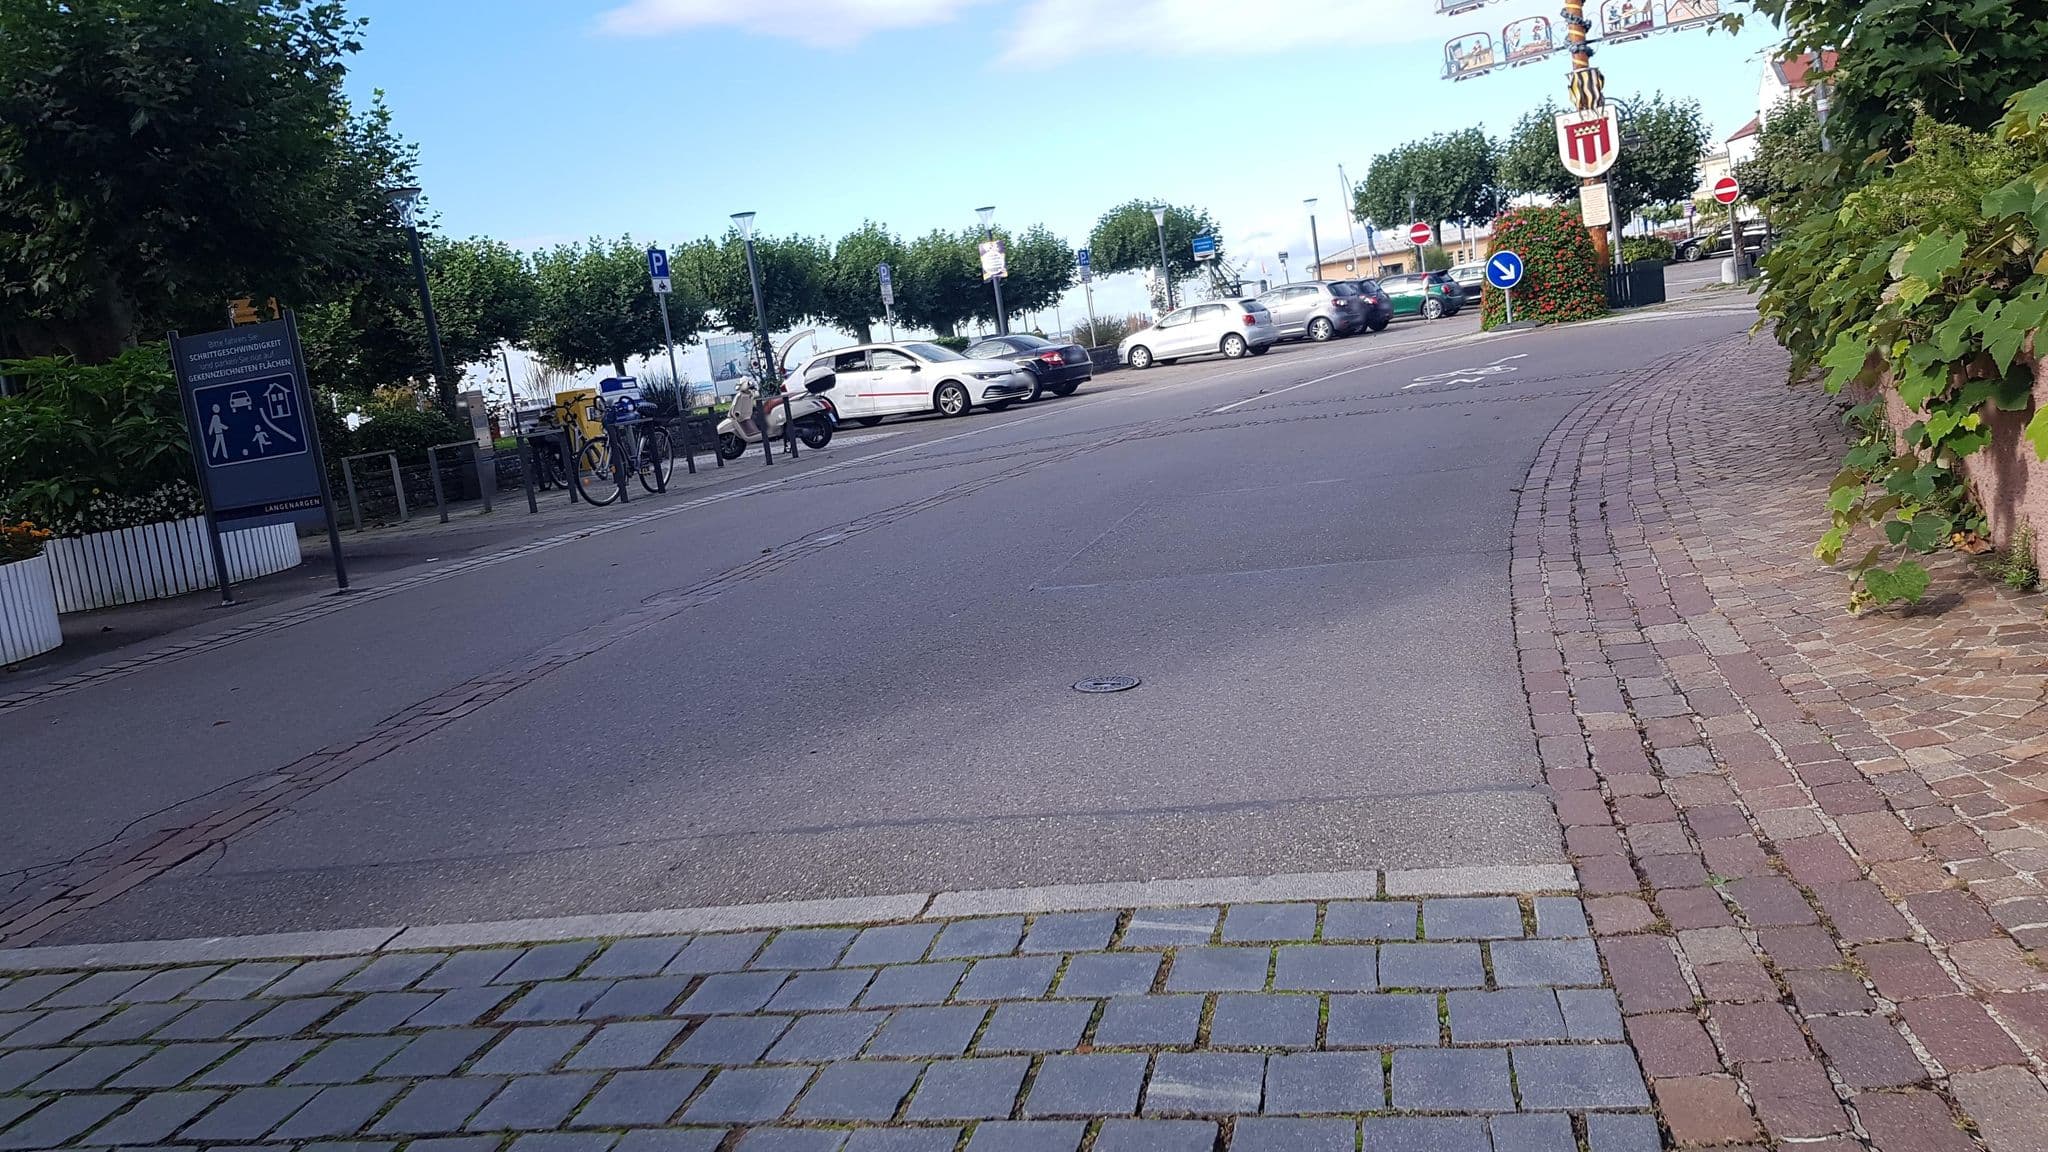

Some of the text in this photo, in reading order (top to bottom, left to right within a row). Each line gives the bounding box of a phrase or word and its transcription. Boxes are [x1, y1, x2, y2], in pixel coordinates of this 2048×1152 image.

[652, 253, 663, 274] P
[1080, 252, 1087, 264] P
[880, 266, 887, 281] P
[189, 339, 282, 362] SCHRITTGESCHWINDIGKEIT
[188, 358, 292, 383] GEKENNZEICHNETEN FLÄCHEN
[264, 498, 320, 513] LANGENARGEN
